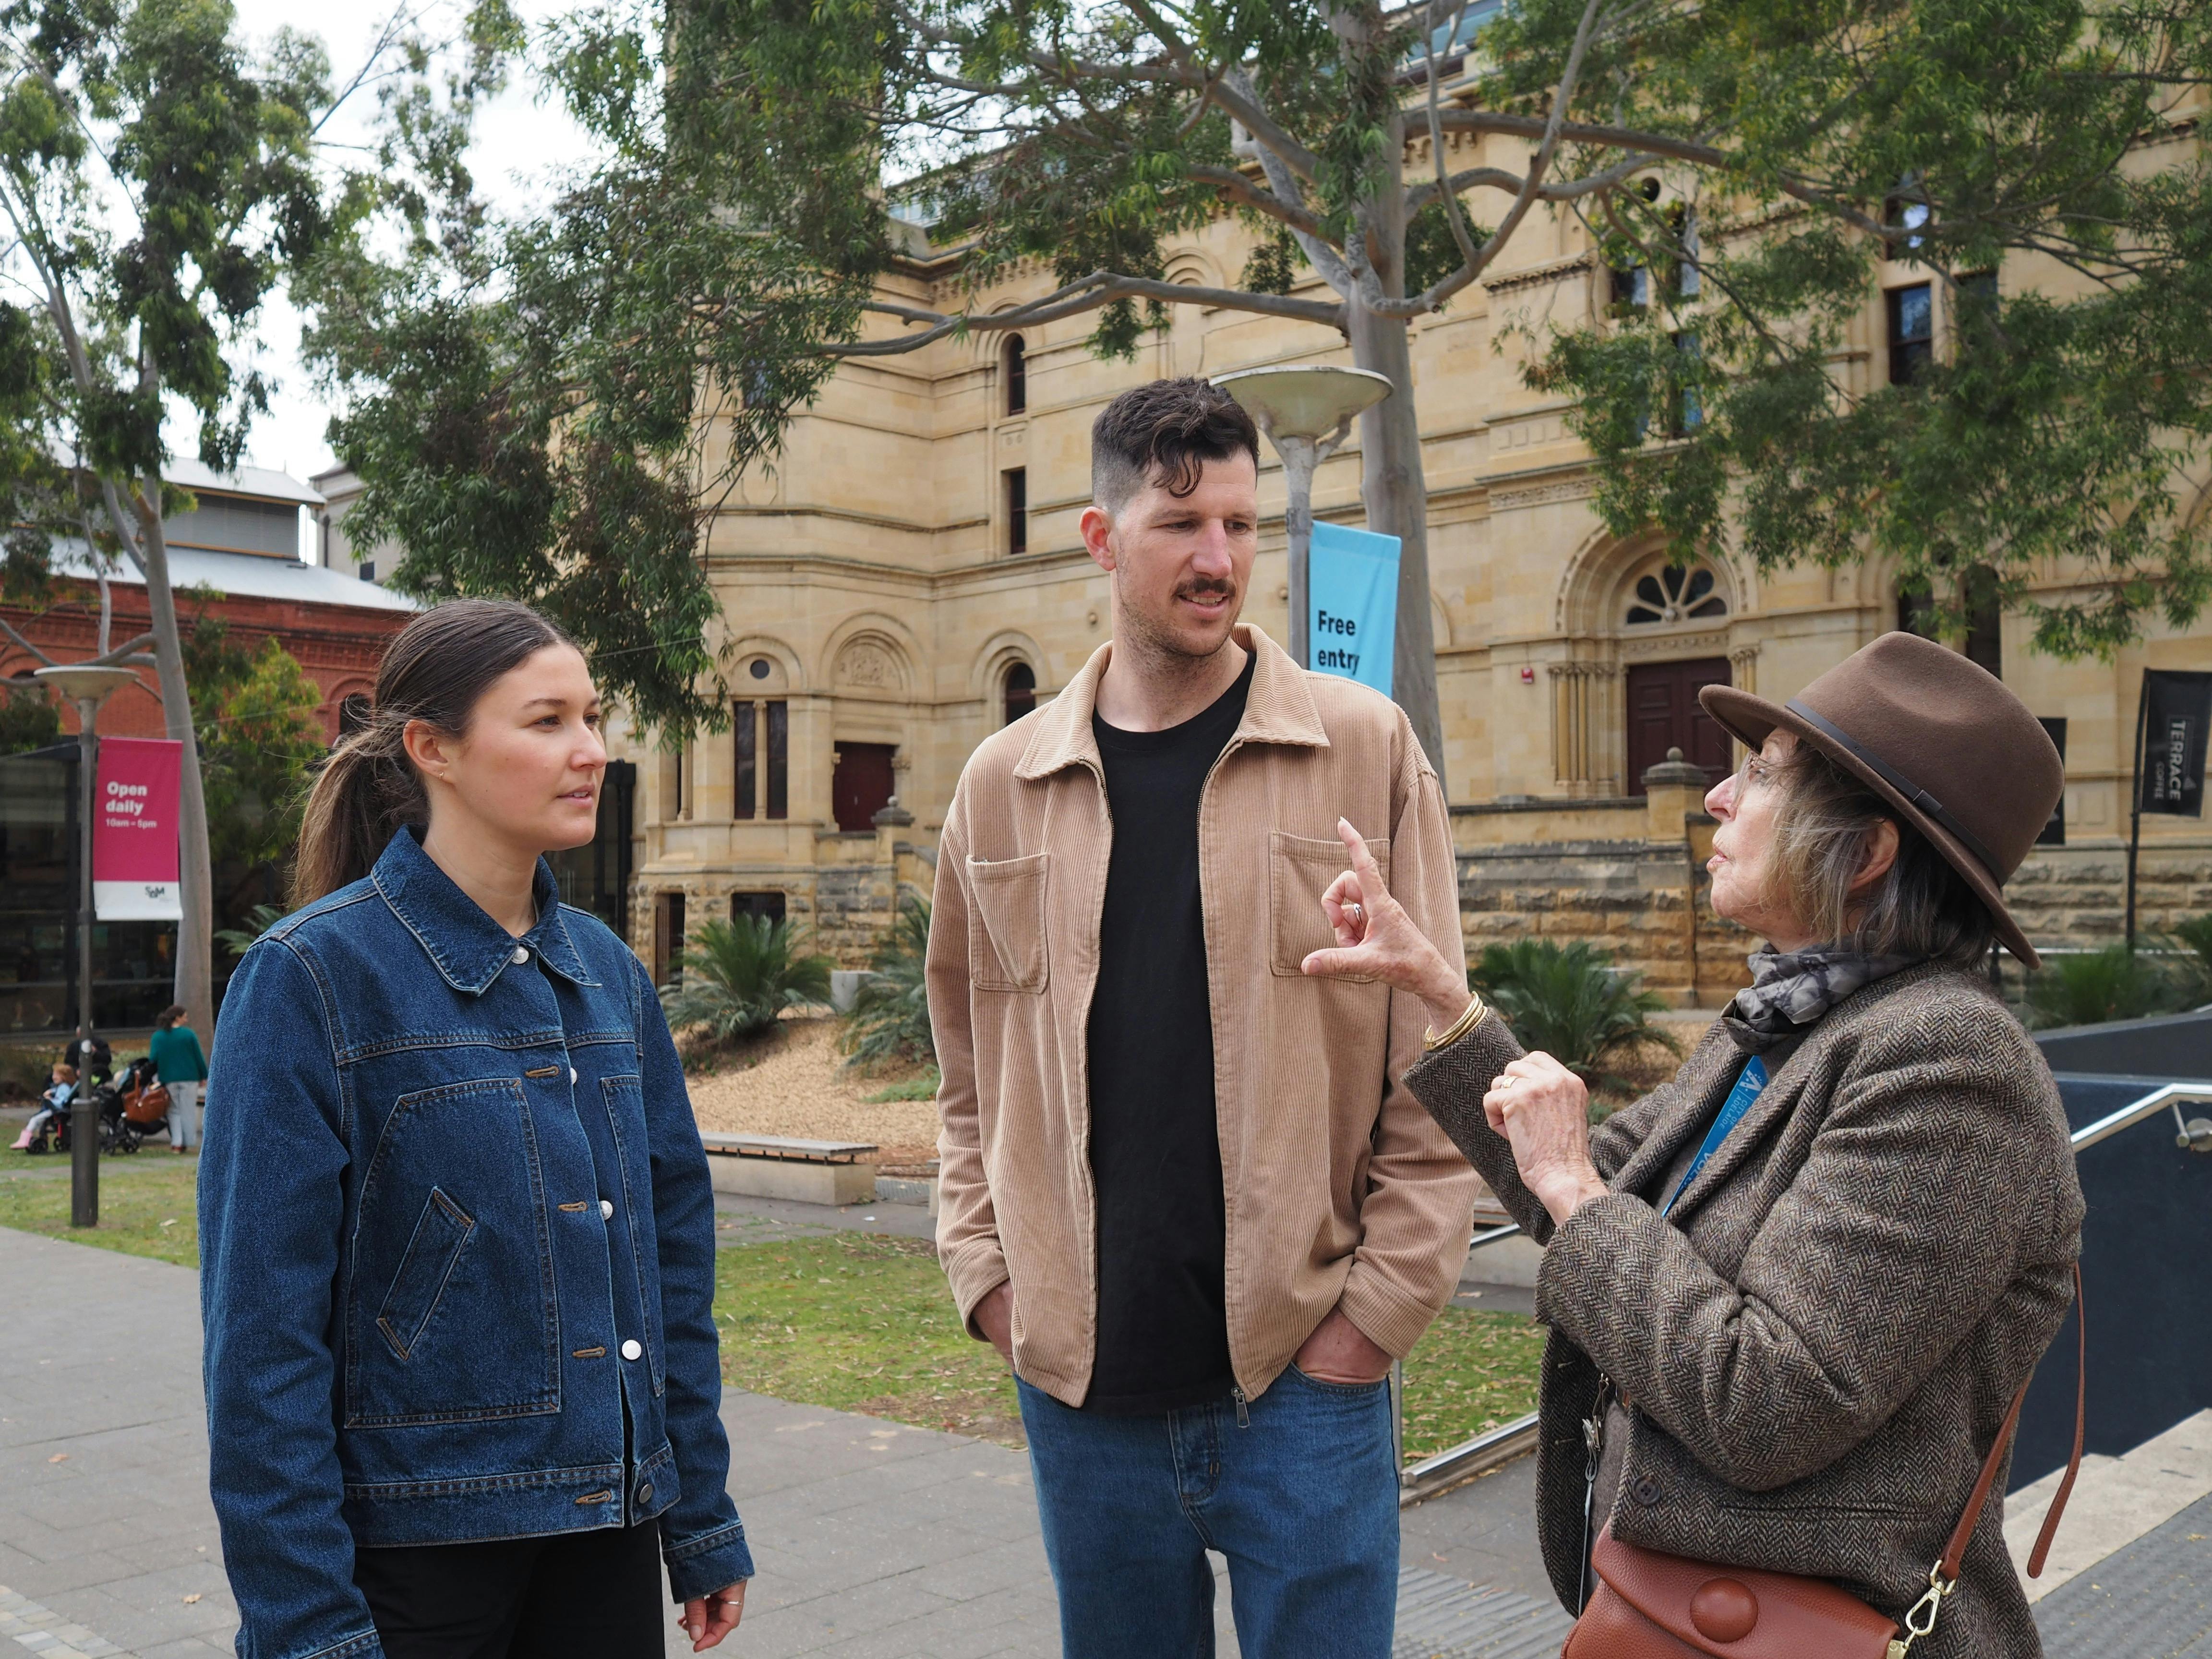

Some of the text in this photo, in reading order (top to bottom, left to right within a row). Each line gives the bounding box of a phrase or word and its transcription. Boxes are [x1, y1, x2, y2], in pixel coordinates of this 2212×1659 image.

[1318, 610, 1356, 636] Free
[1318, 648, 1360, 676] entry
[2169, 720, 2187, 801] TERRACE
[106, 781, 148, 798] Open
[106, 799, 144, 816] daily
[106, 817, 130, 827] 10am
[137, 818, 157, 830] 5pm
[1719, 1094, 1743, 1130] ADELAIDE
[1729, 1099, 1748, 1127] CITY OF
